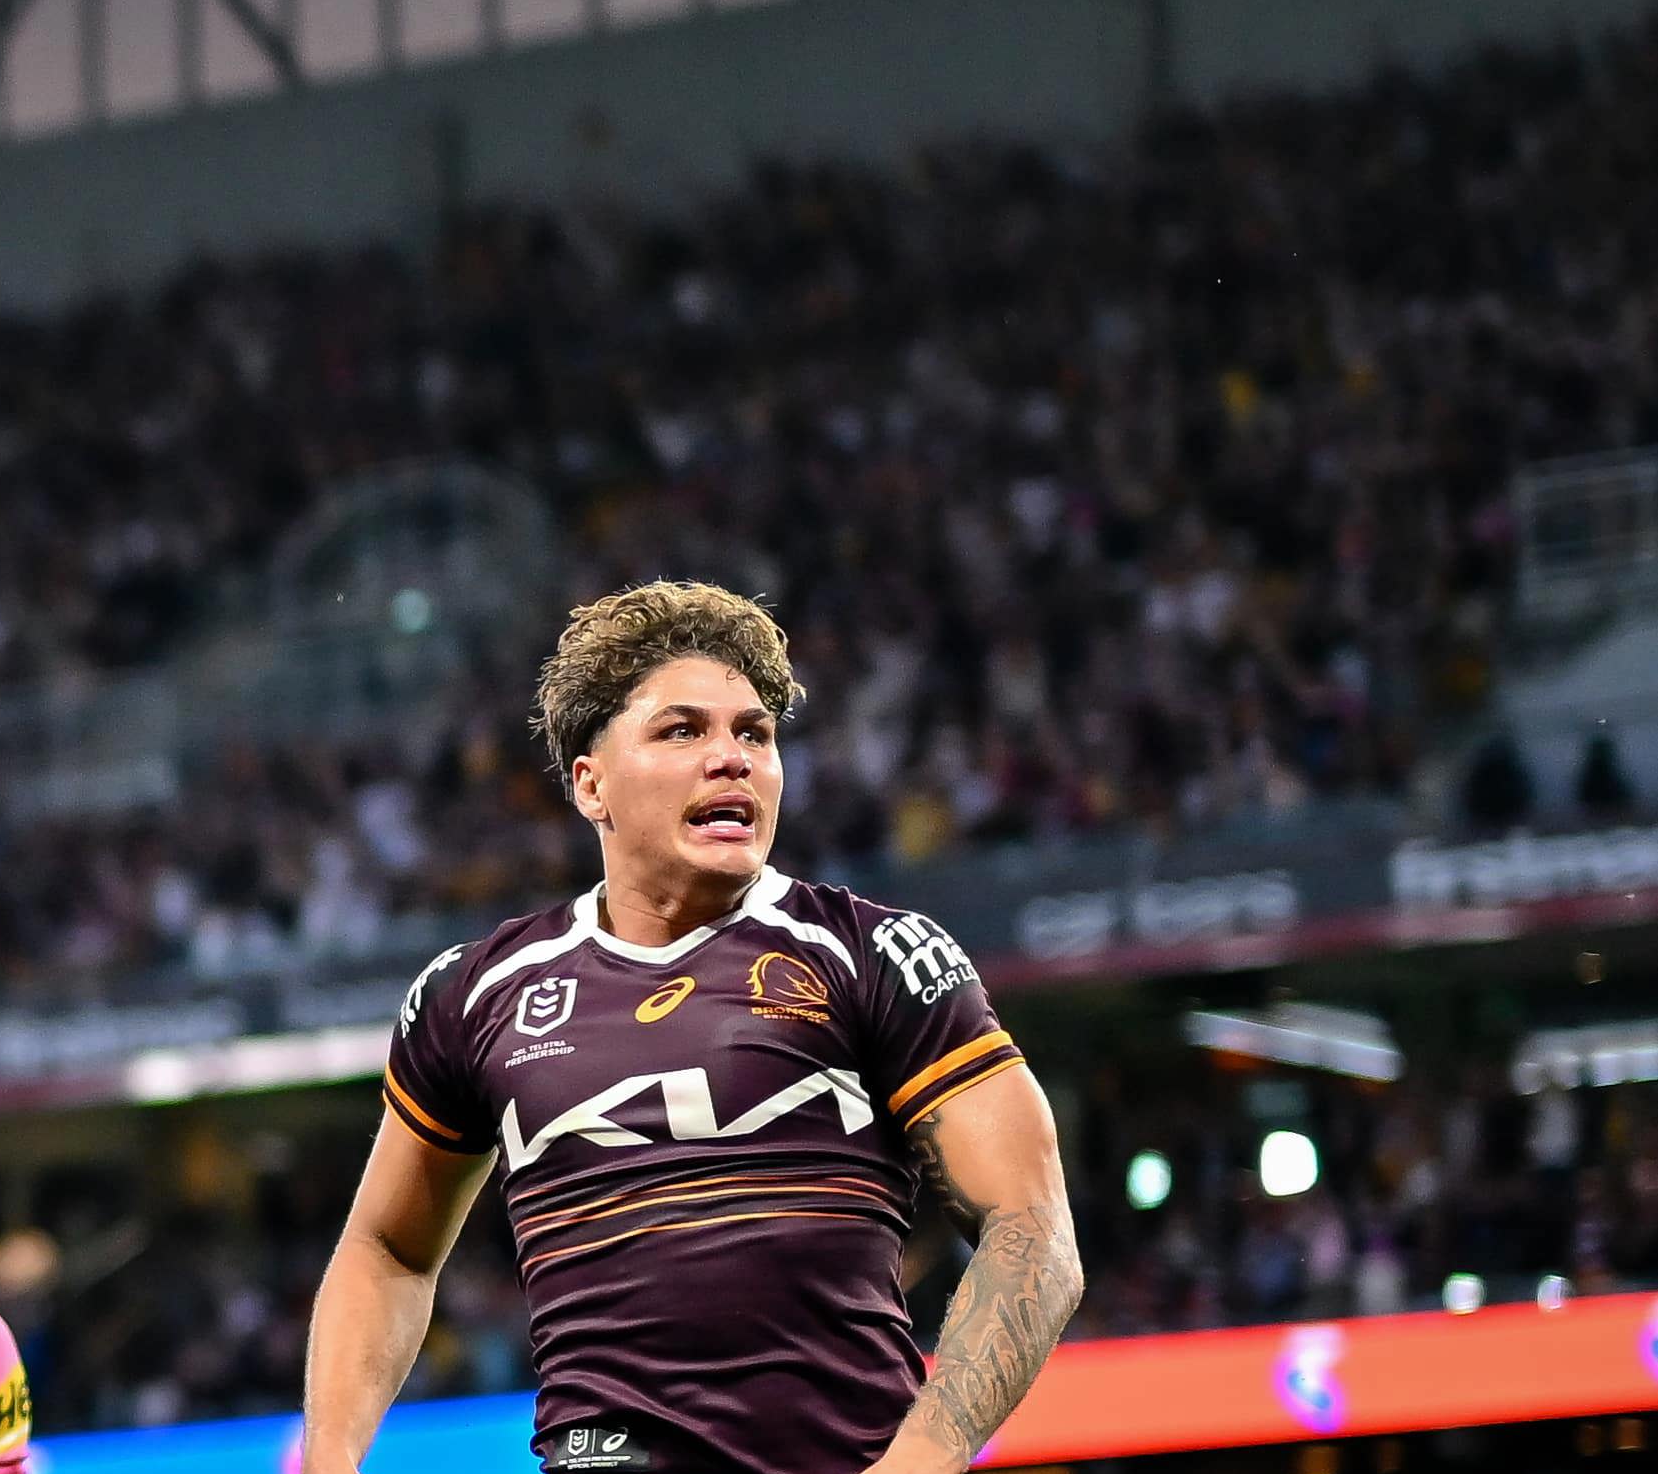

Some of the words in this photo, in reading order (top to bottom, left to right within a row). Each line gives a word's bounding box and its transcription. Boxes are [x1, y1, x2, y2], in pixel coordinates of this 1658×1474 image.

[922, 973, 960, 1005] CAR
[751, 1006, 831, 1021] BRONCOS
[505, 1046, 576, 1069] PREMIERSHIP
[501, 1067, 874, 1173] KIA
